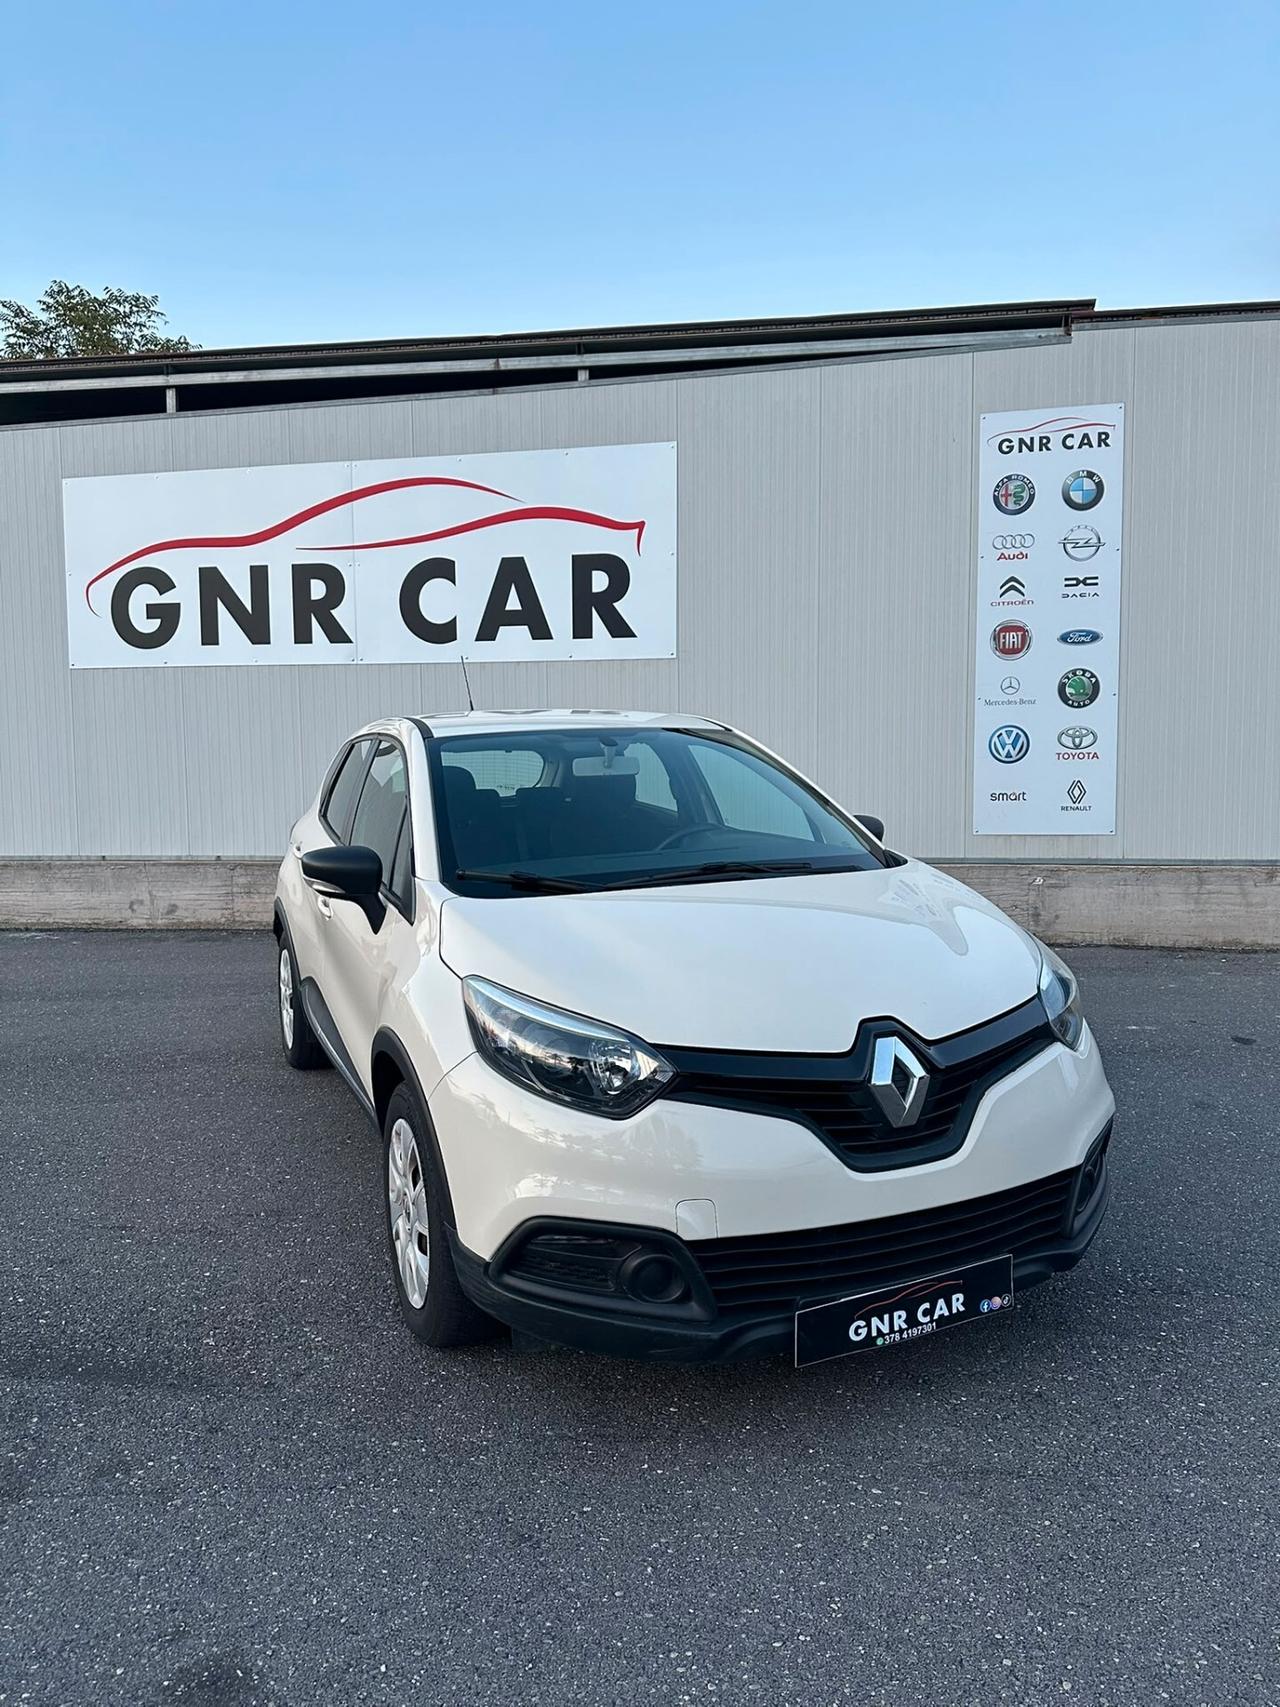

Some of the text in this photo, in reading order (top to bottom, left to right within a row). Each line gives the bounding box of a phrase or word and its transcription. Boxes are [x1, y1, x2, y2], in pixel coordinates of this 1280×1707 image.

[998, 431, 1111, 455] GNR CAR
[996, 551, 1029, 561] Audi
[110, 552, 639, 650] GNR CAR
[1000, 631, 1023, 649] FIAT
[1066, 631, 1094, 643] Ford
[1067, 699, 1091, 707] AUTO
[1055, 751, 1100, 761] TOYOTA
[989, 791, 1027, 802] smart
[849, 1292, 966, 1342] GNR CAR
[884, 1321, 937, 1344] 378 4197301
